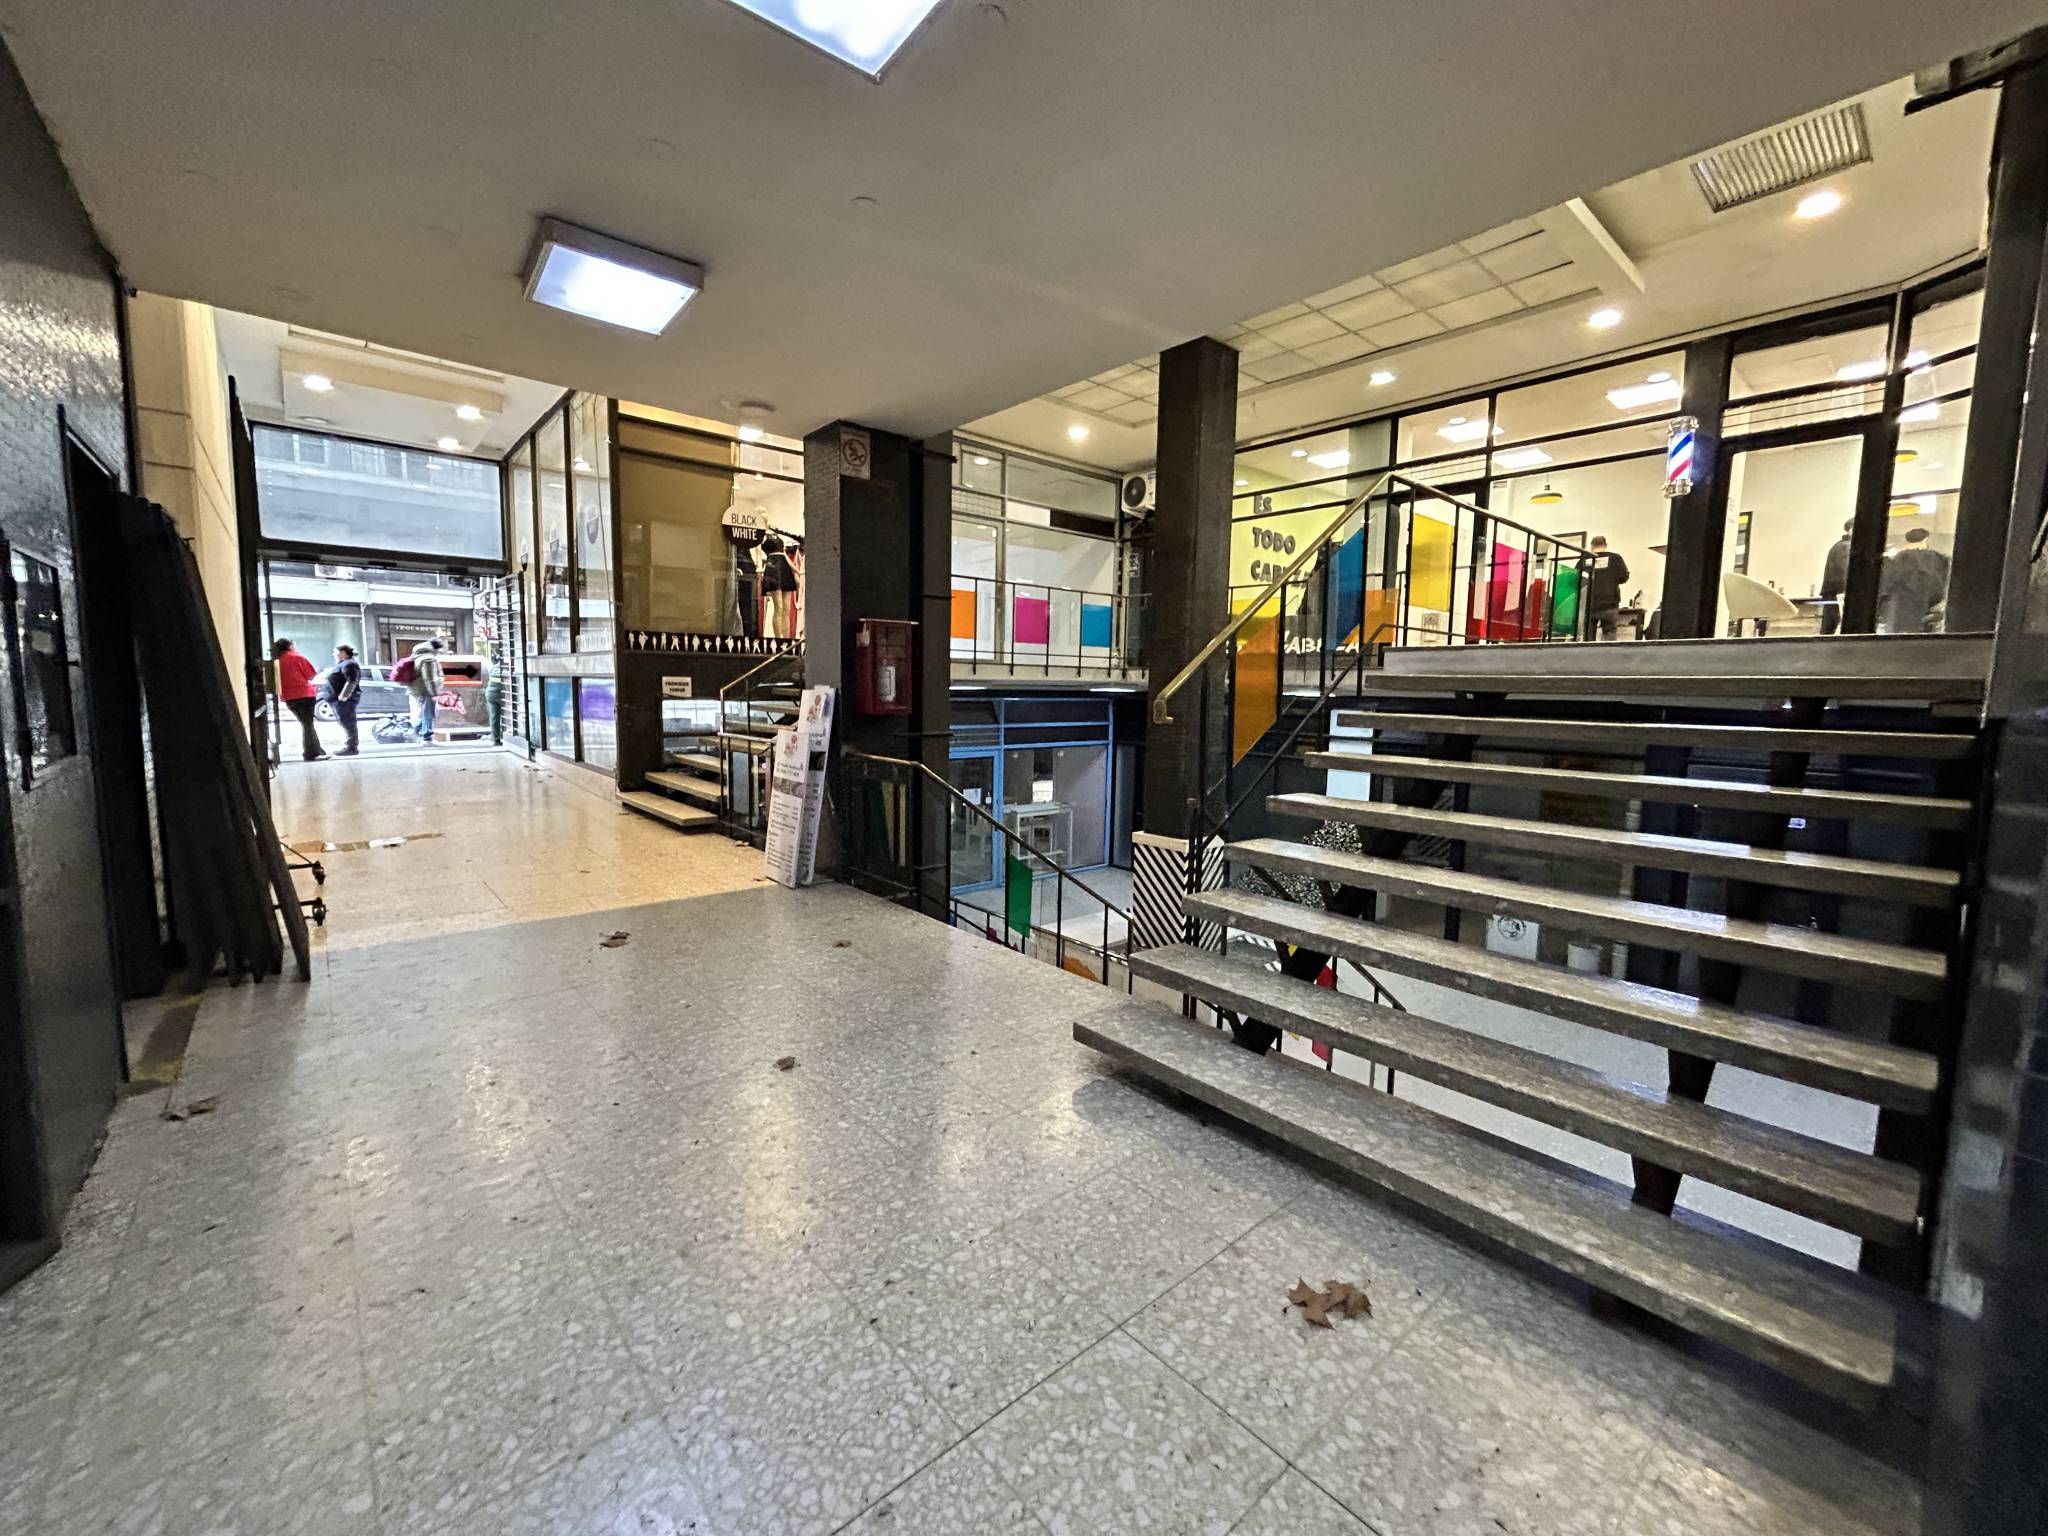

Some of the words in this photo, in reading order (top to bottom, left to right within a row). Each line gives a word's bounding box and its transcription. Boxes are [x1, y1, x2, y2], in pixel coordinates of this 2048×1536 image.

[1253, 493, 1273, 515] ES
[731, 513, 757, 527] BLACK
[732, 526, 758, 541] WHITE
[1252, 526, 1296, 555] TODO
